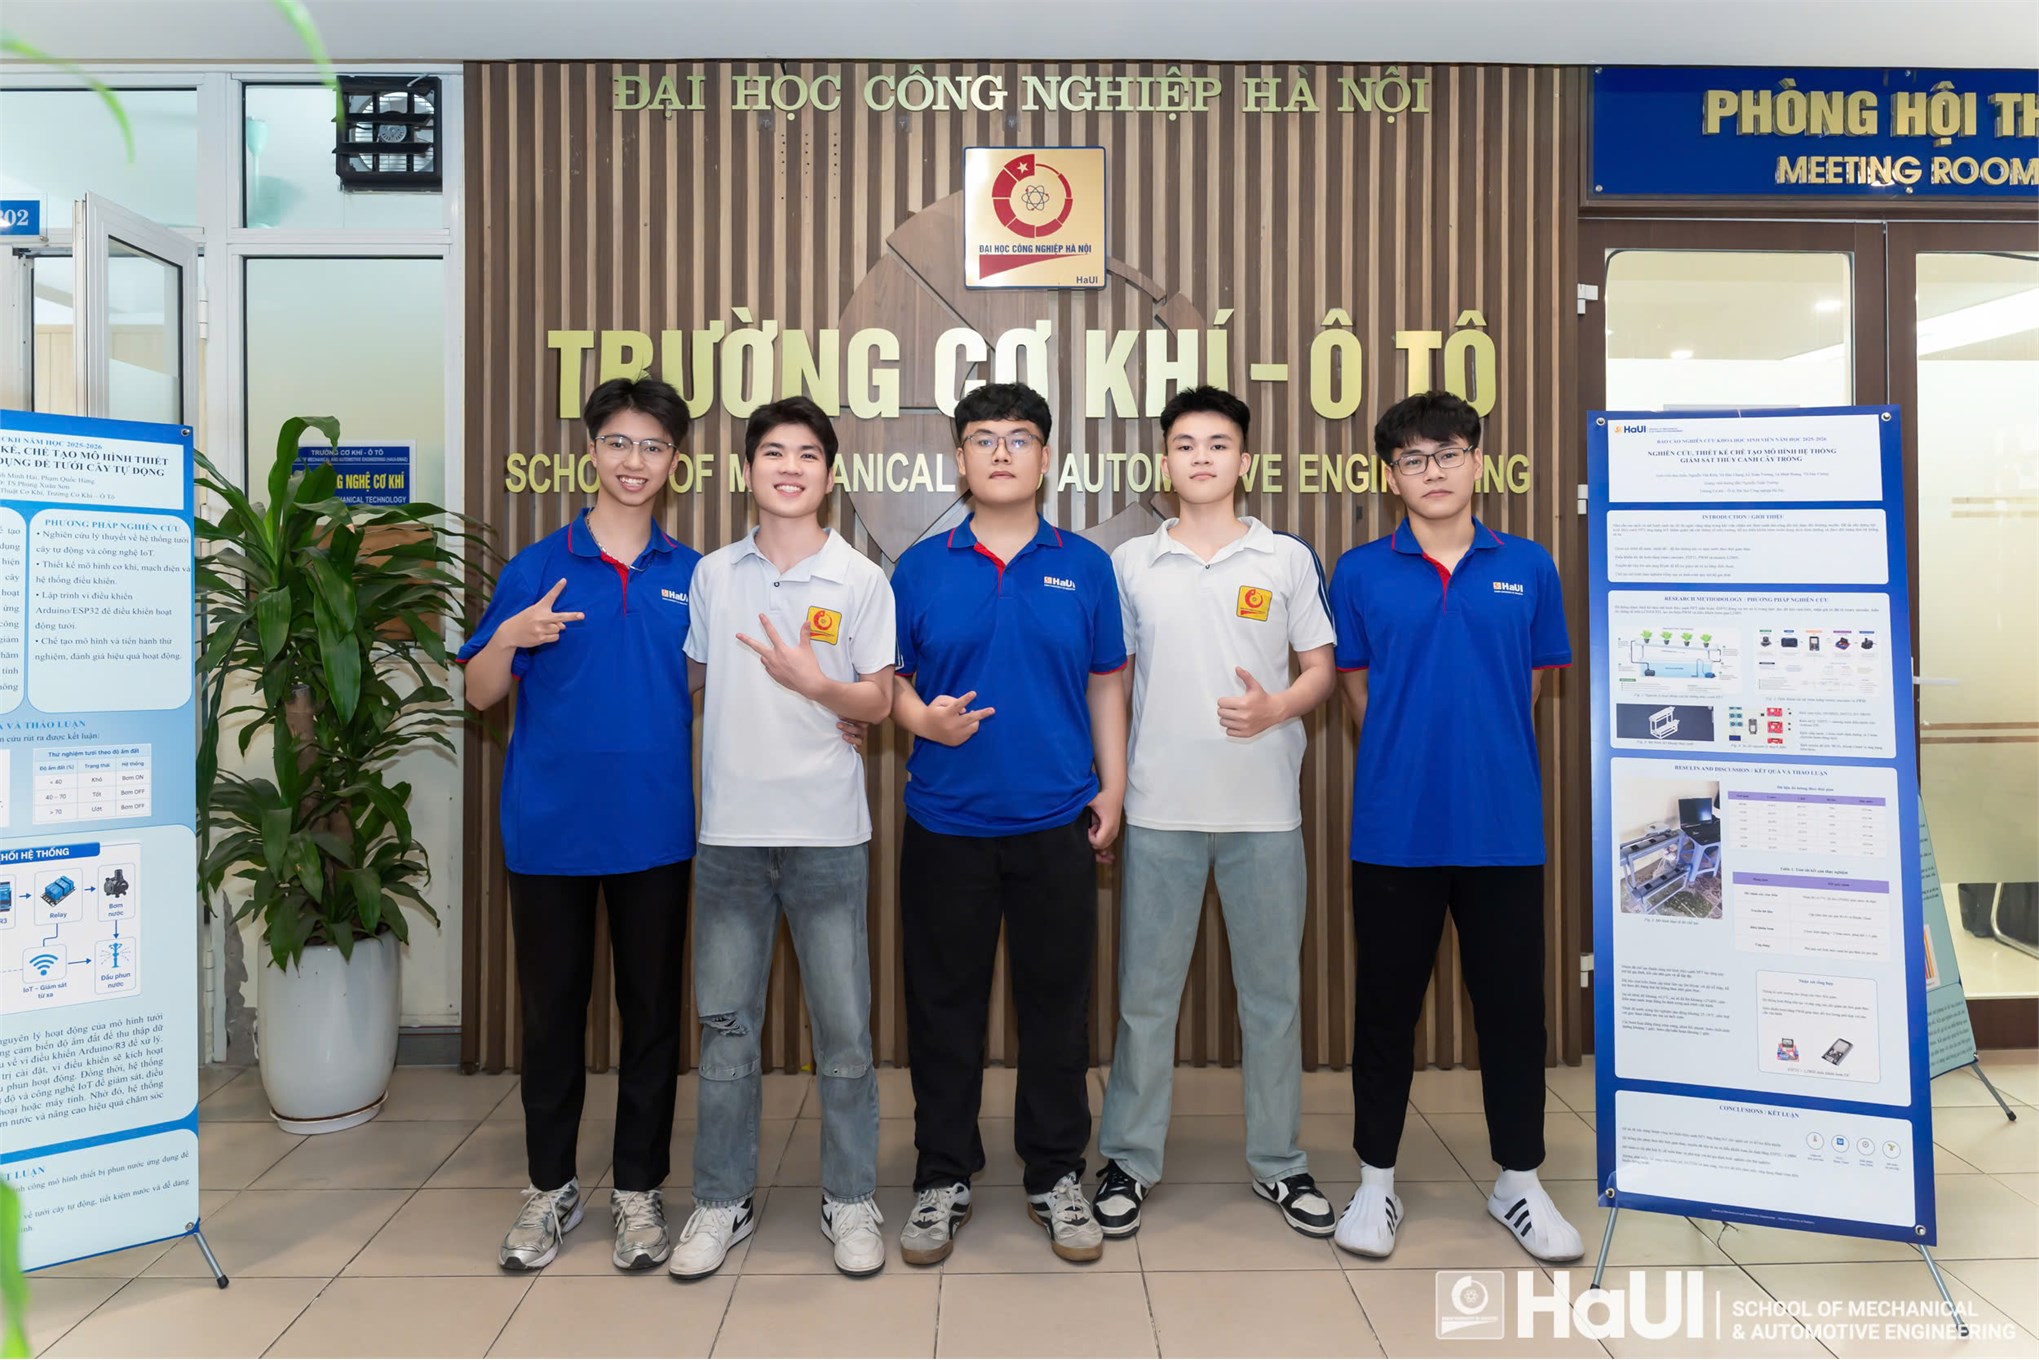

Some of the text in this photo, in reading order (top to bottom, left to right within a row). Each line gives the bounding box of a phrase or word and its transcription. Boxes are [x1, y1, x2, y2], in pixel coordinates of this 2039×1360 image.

[614, 64, 1430, 123] ĐẠI HỌC CÔNG NGHIỆP HÀ NỘI
[1703, 78, 1878, 137] PHÒNG
[1891, 81, 1977, 147] HỘI
[1776, 155, 2039, 185] MEETING ROOM
[979, 243, 1092, 255] ĐẠI HỌC CÔNG NGHIỆP HÀ NỘI
[1076, 276, 1098, 284] HaUI
[547, 307, 900, 420] TRƯỜNG
[935, 320, 1052, 418] CƠ
[1085, 309, 1234, 418] KHÍ
[1310, 308, 1363, 419] Ô
[1395, 310, 1497, 418] TÔ
[52, 450, 77, 460] TẠO
[81, 451, 99, 461] MÔ
[133, 467, 165, 477] ĐỘNG
[505, 453, 600, 494] SCHO
[668, 453, 715, 494] OF
[728, 453, 956, 493] MANICAL
[1057, 453, 1283, 493] AUTOMVE
[1300, 453, 1531, 494] ENGING
[346, 471, 370, 492] NGHỆ
[373, 474, 386, 489] CƠ
[388, 471, 405, 489] KHÍ
[341, 496, 407, 504] ANICAL TECHNOLOGY
[1502, 582, 1523, 593] HaUI
[58, 720, 86, 730] LUẬN
[0, 846, 70, 861] HỐI HỆ THỐNG
[115, 972, 131, 980] phun
[45, 1029, 63, 1039] hoạt
[66, 1026, 88, 1036] động
[71, 1107, 86, 1115] cao
